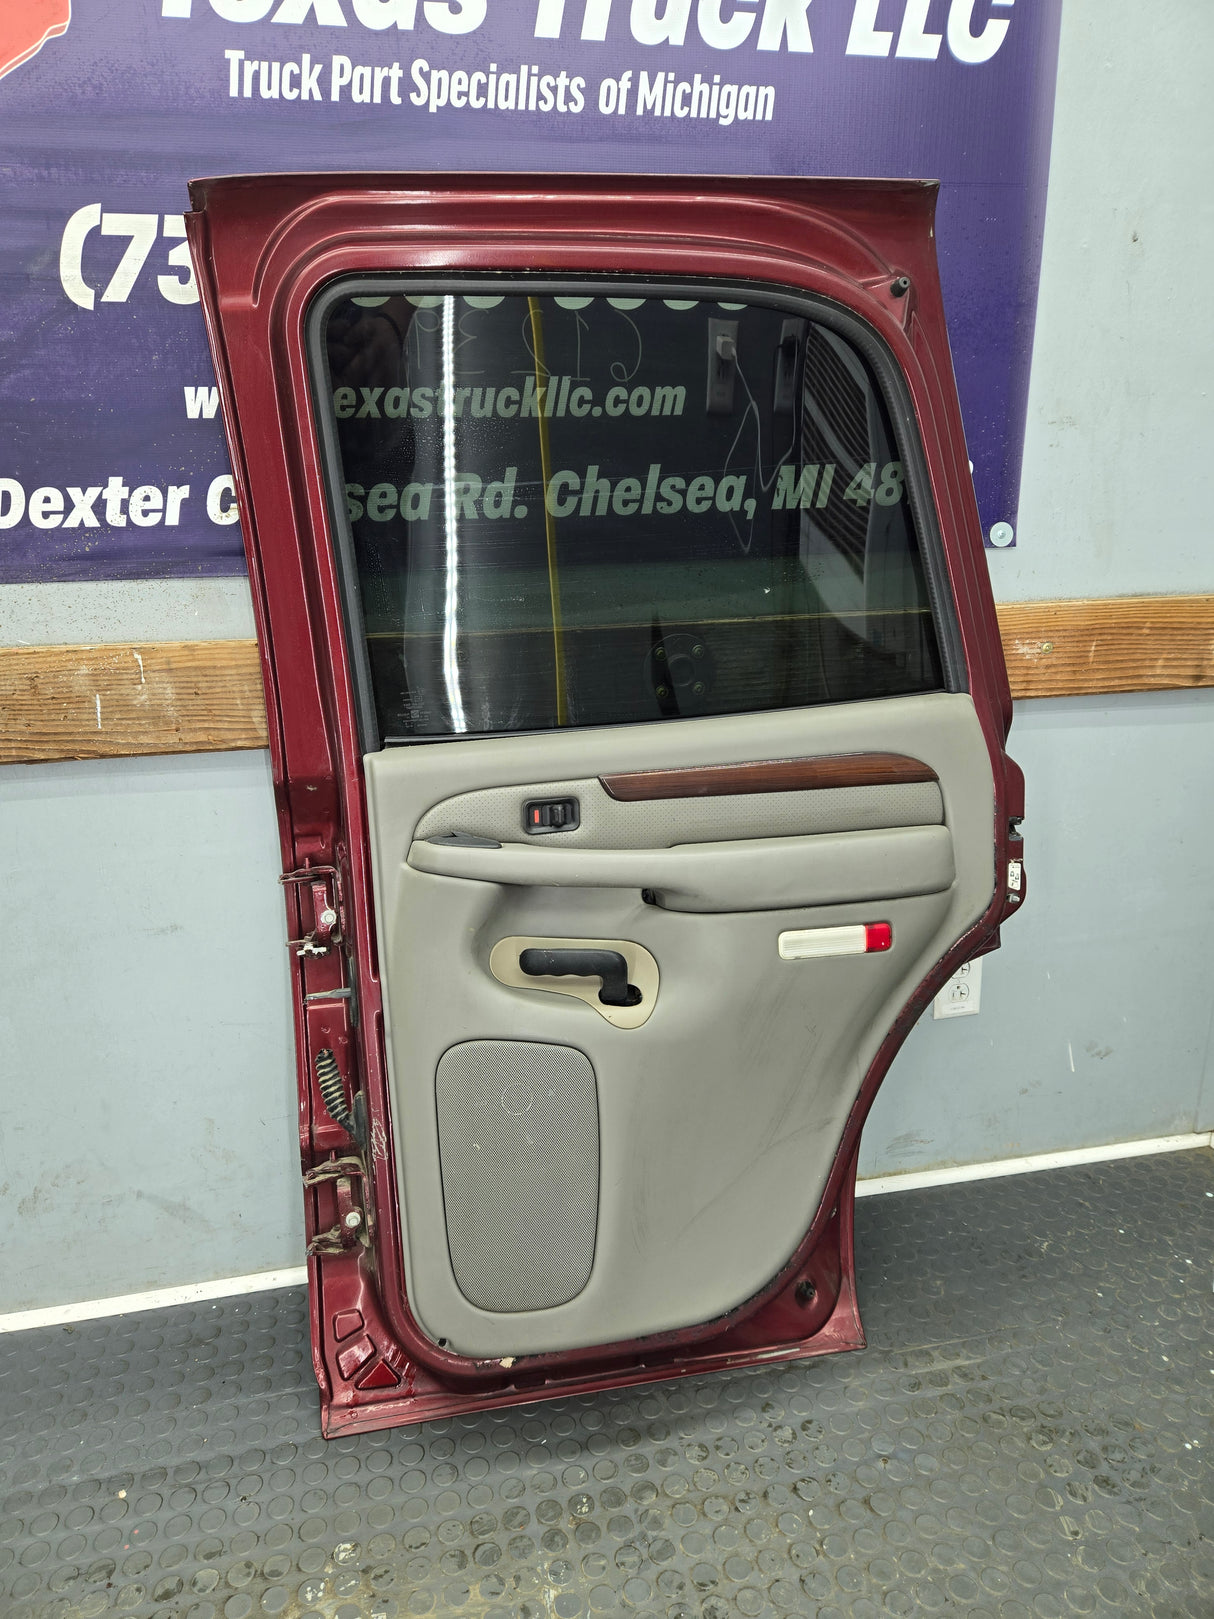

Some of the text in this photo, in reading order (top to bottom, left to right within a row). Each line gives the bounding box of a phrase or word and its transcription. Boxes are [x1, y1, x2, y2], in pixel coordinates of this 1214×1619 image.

[845, 0, 1014, 63] LLC
[225, 50, 776, 126] Truck Part Specialists of Michigan
[59, 203, 200, 311] (73
[0, 476, 190, 530] Dexter
[448, 467, 528, 521] Rd.
[546, 463, 758, 520] Chelsea,
[771, 465, 832, 510] MI
